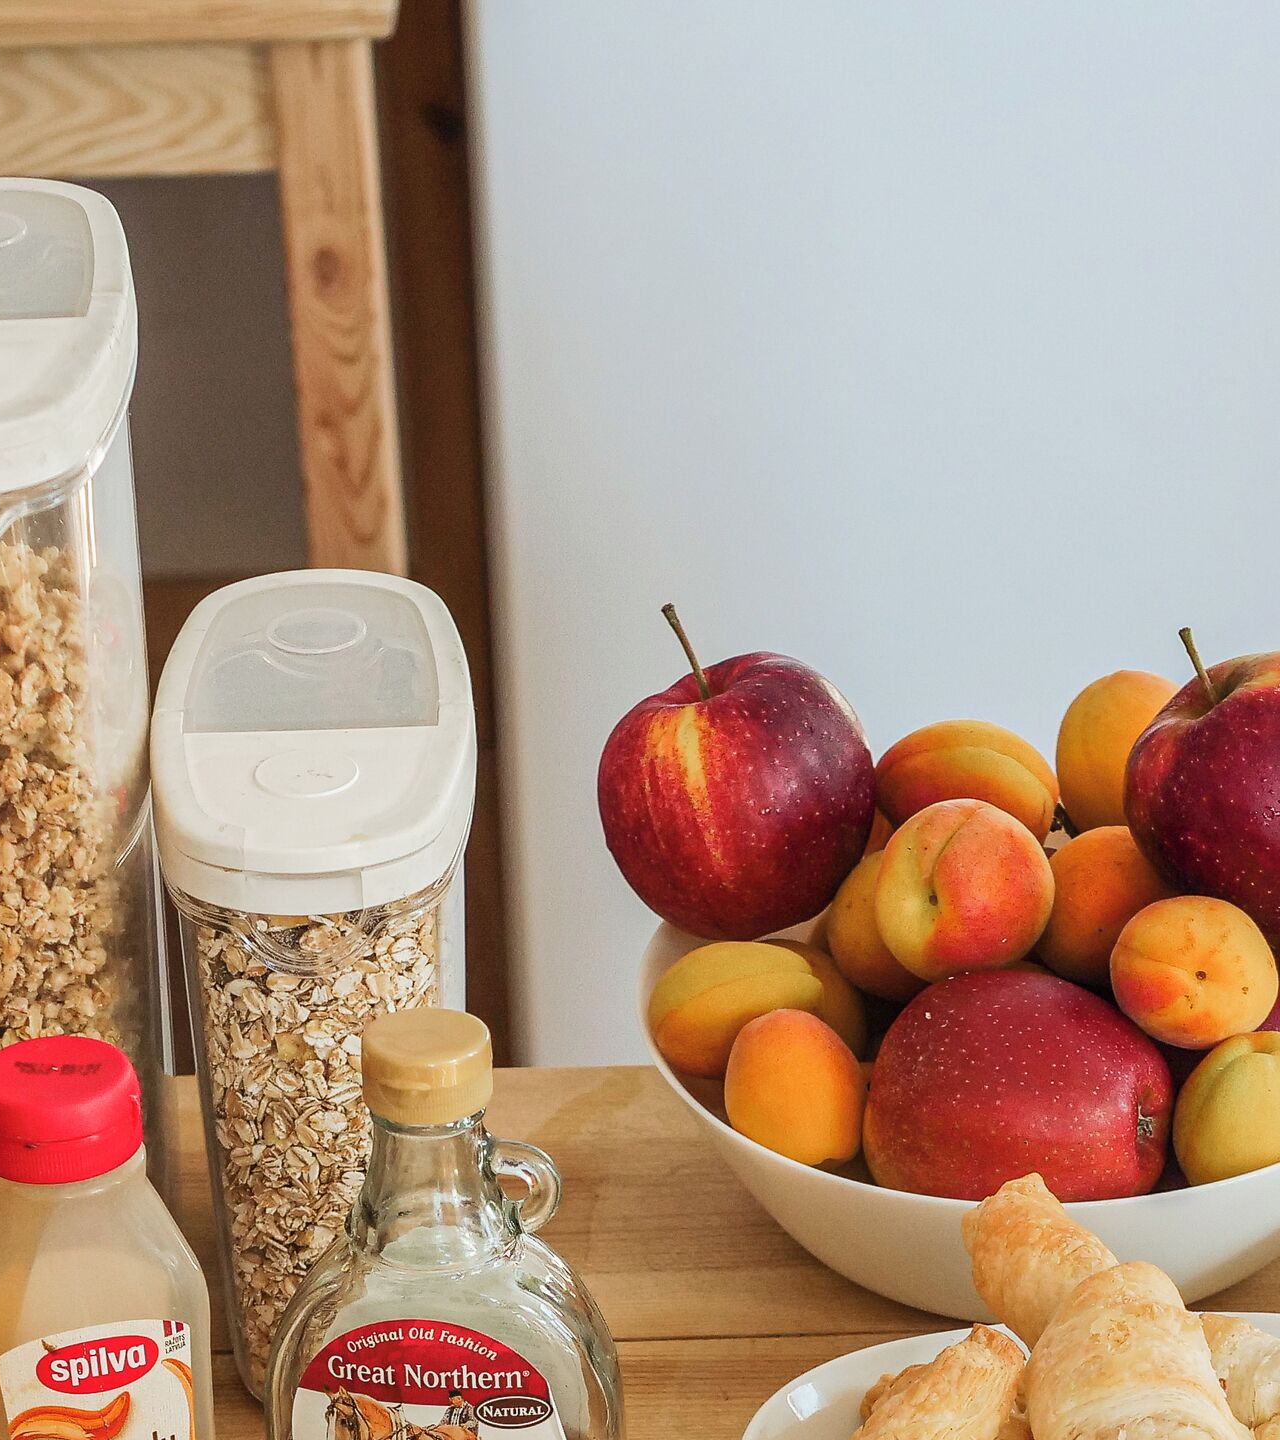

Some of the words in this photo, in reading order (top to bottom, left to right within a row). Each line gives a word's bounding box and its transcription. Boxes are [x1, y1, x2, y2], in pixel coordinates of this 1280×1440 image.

[347, 1328, 403, 1353] Original
[409, 1327, 434, 1341] Old
[439, 1330, 498, 1361] Fashion
[50, 1341, 147, 1387] spilva
[328, 1355, 396, 1385] Great
[483, 1404, 546, 1418] NATURAL
